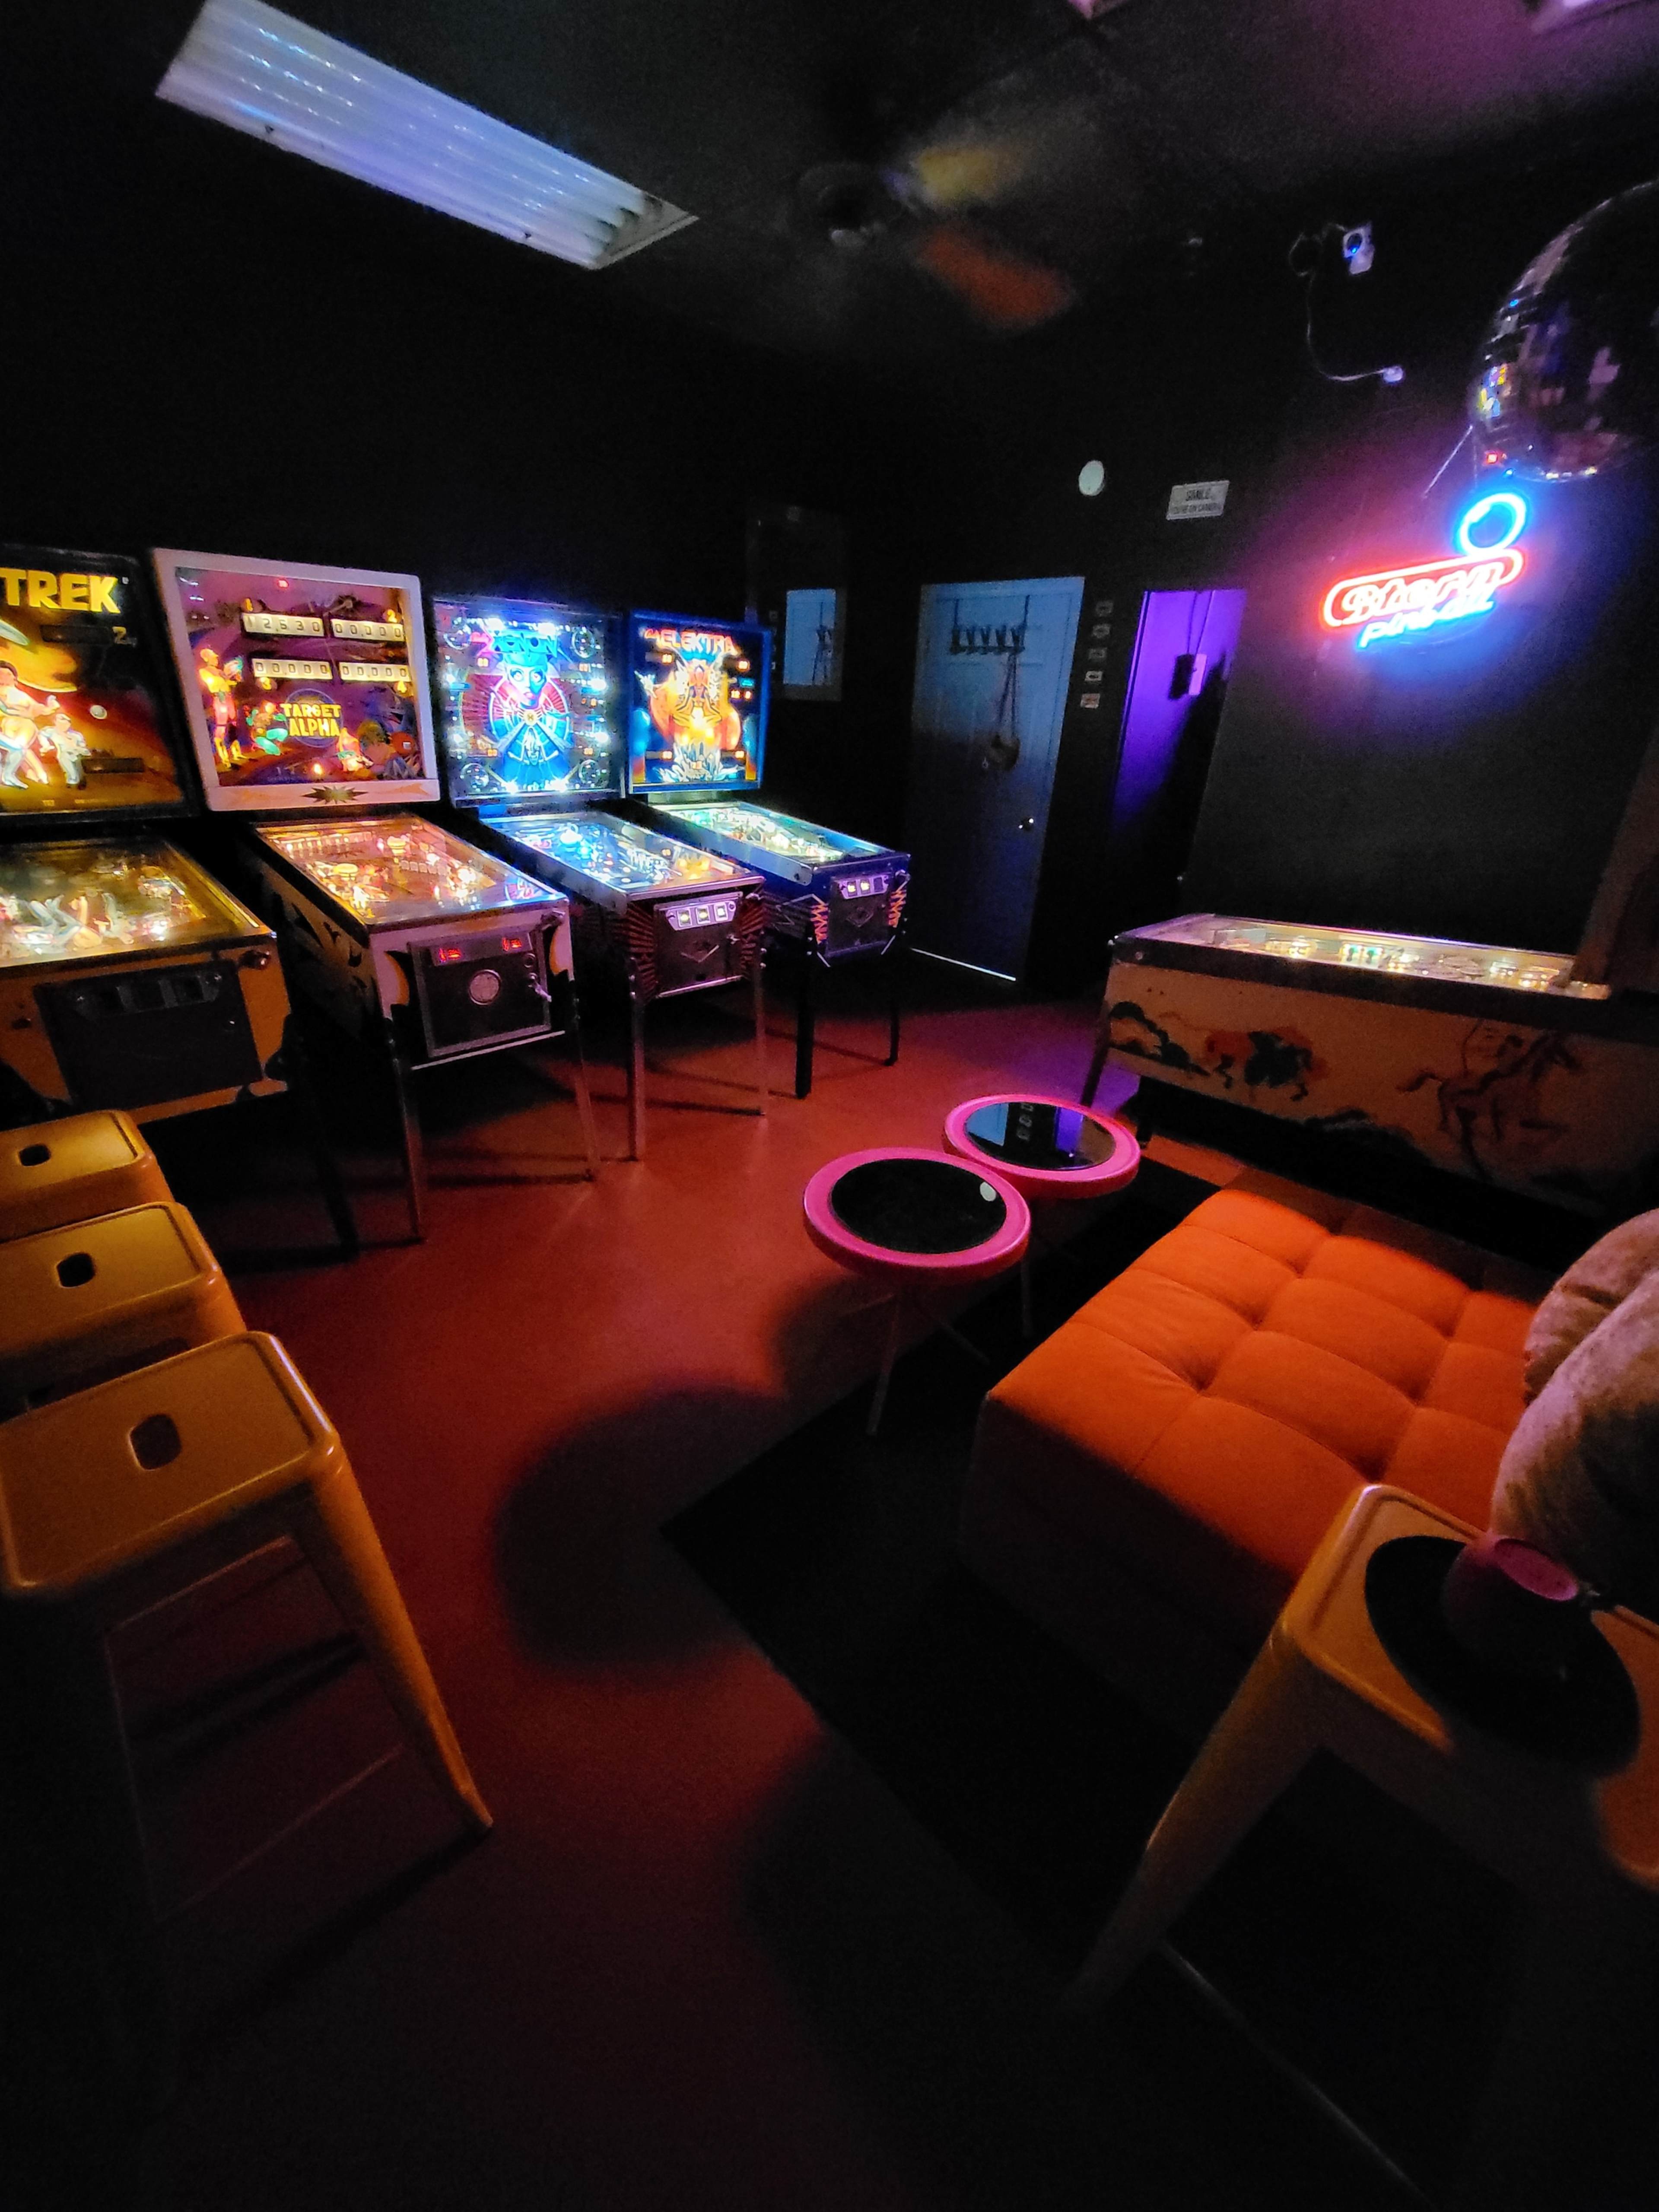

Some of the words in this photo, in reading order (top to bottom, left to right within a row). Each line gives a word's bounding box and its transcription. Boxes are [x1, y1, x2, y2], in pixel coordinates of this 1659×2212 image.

[0, 567, 121, 613] TREK
[659, 629, 738, 656] ELEKTRA
[280, 703, 341, 717] TARGET
[289, 718, 341, 737] ALPHA
